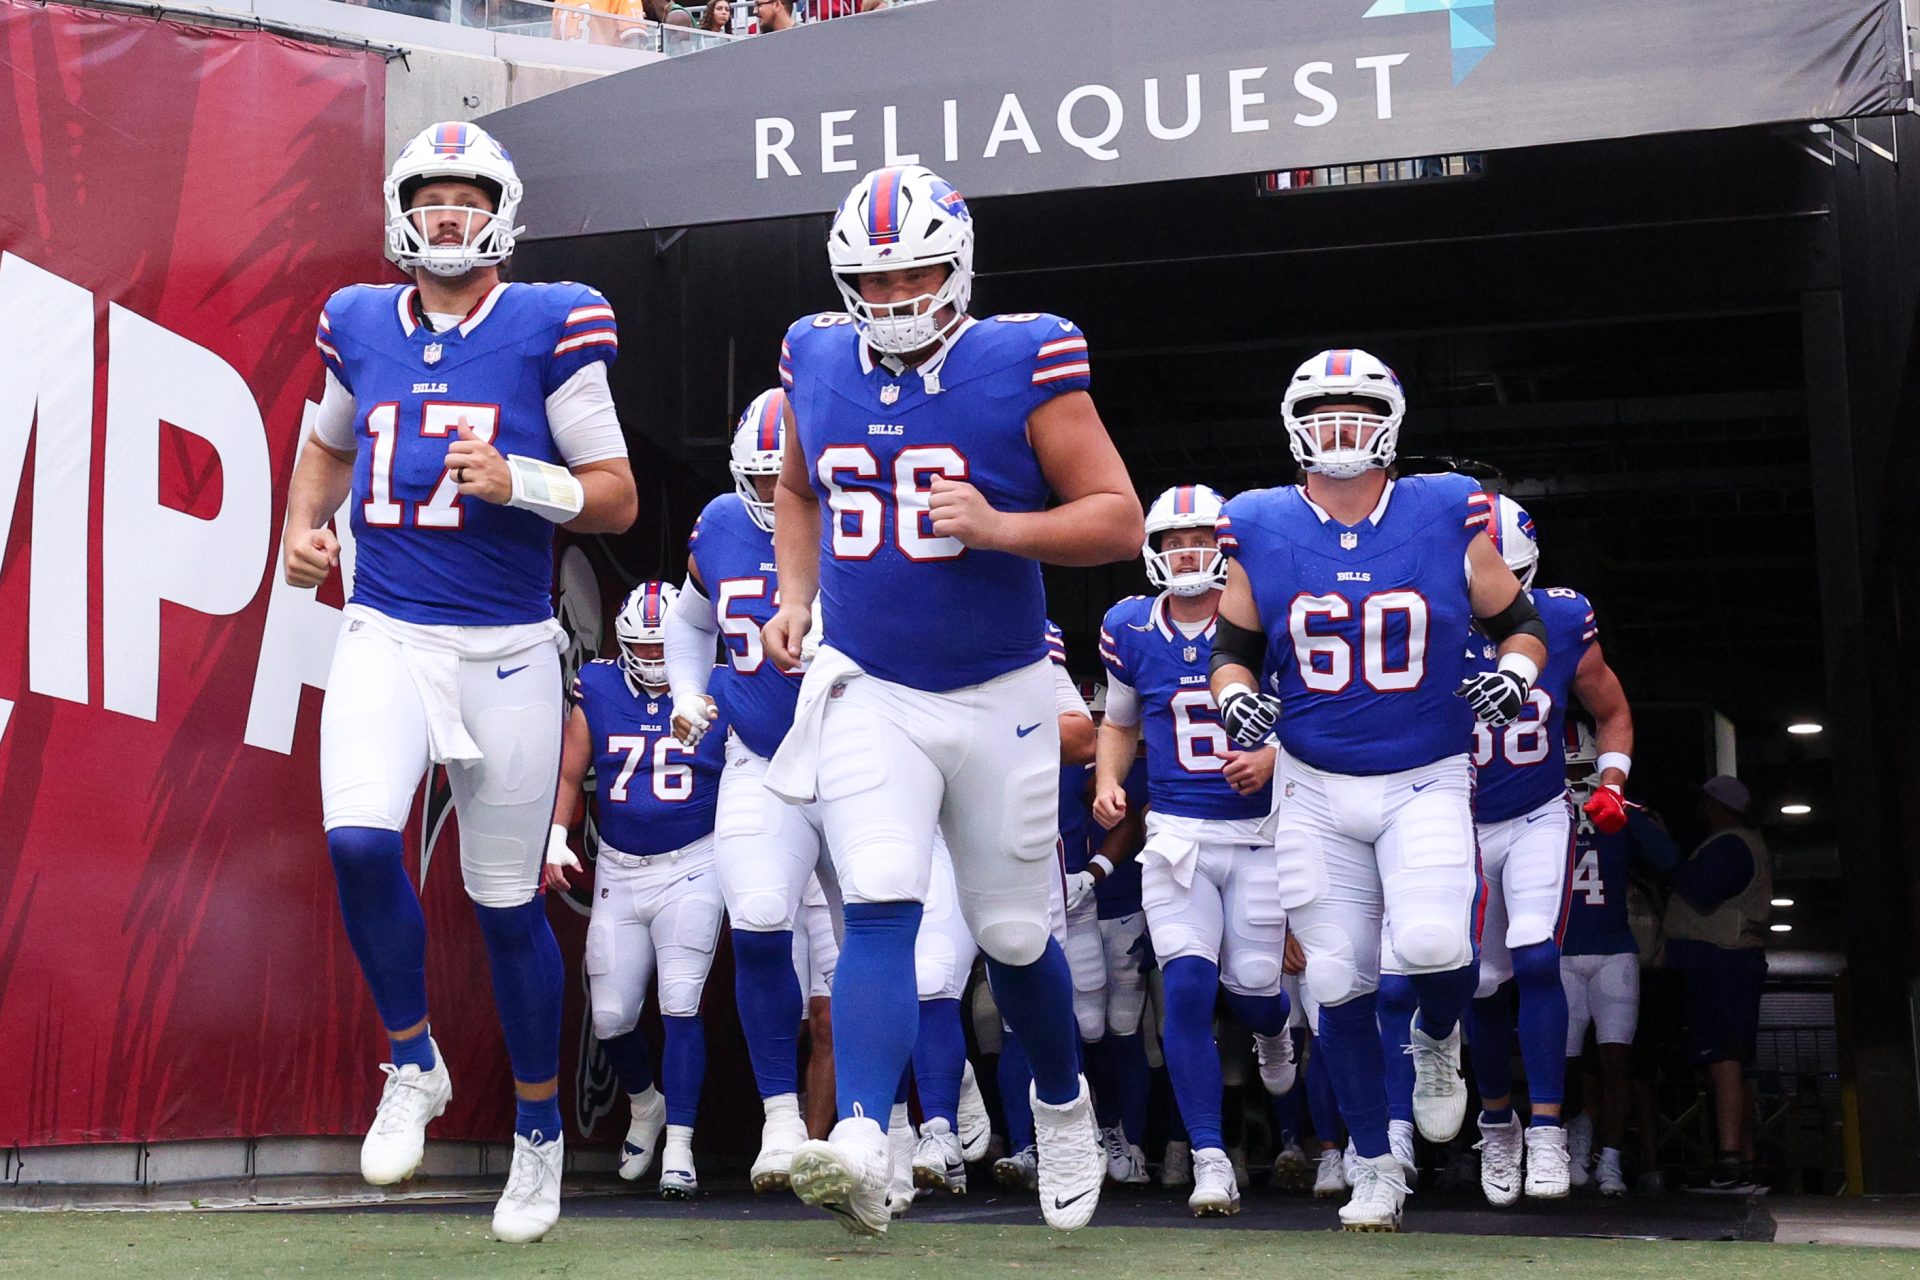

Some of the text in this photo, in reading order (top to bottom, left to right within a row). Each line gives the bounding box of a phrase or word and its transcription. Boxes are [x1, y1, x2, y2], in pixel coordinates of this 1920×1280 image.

[755, 53, 1410, 179] RELIAQUEST
[412, 383, 448, 393] BILLS
[868, 424, 904, 435] BILLS
[362, 400, 500, 531] 17
[816, 443, 969, 562] 66
[1337, 571, 1371, 582] BILLS
[1288, 588, 1431, 695] 60
[1180, 675, 1207, 685] BILLS
[640, 724, 662, 732] BILLS
[608, 734, 695, 803] 76
